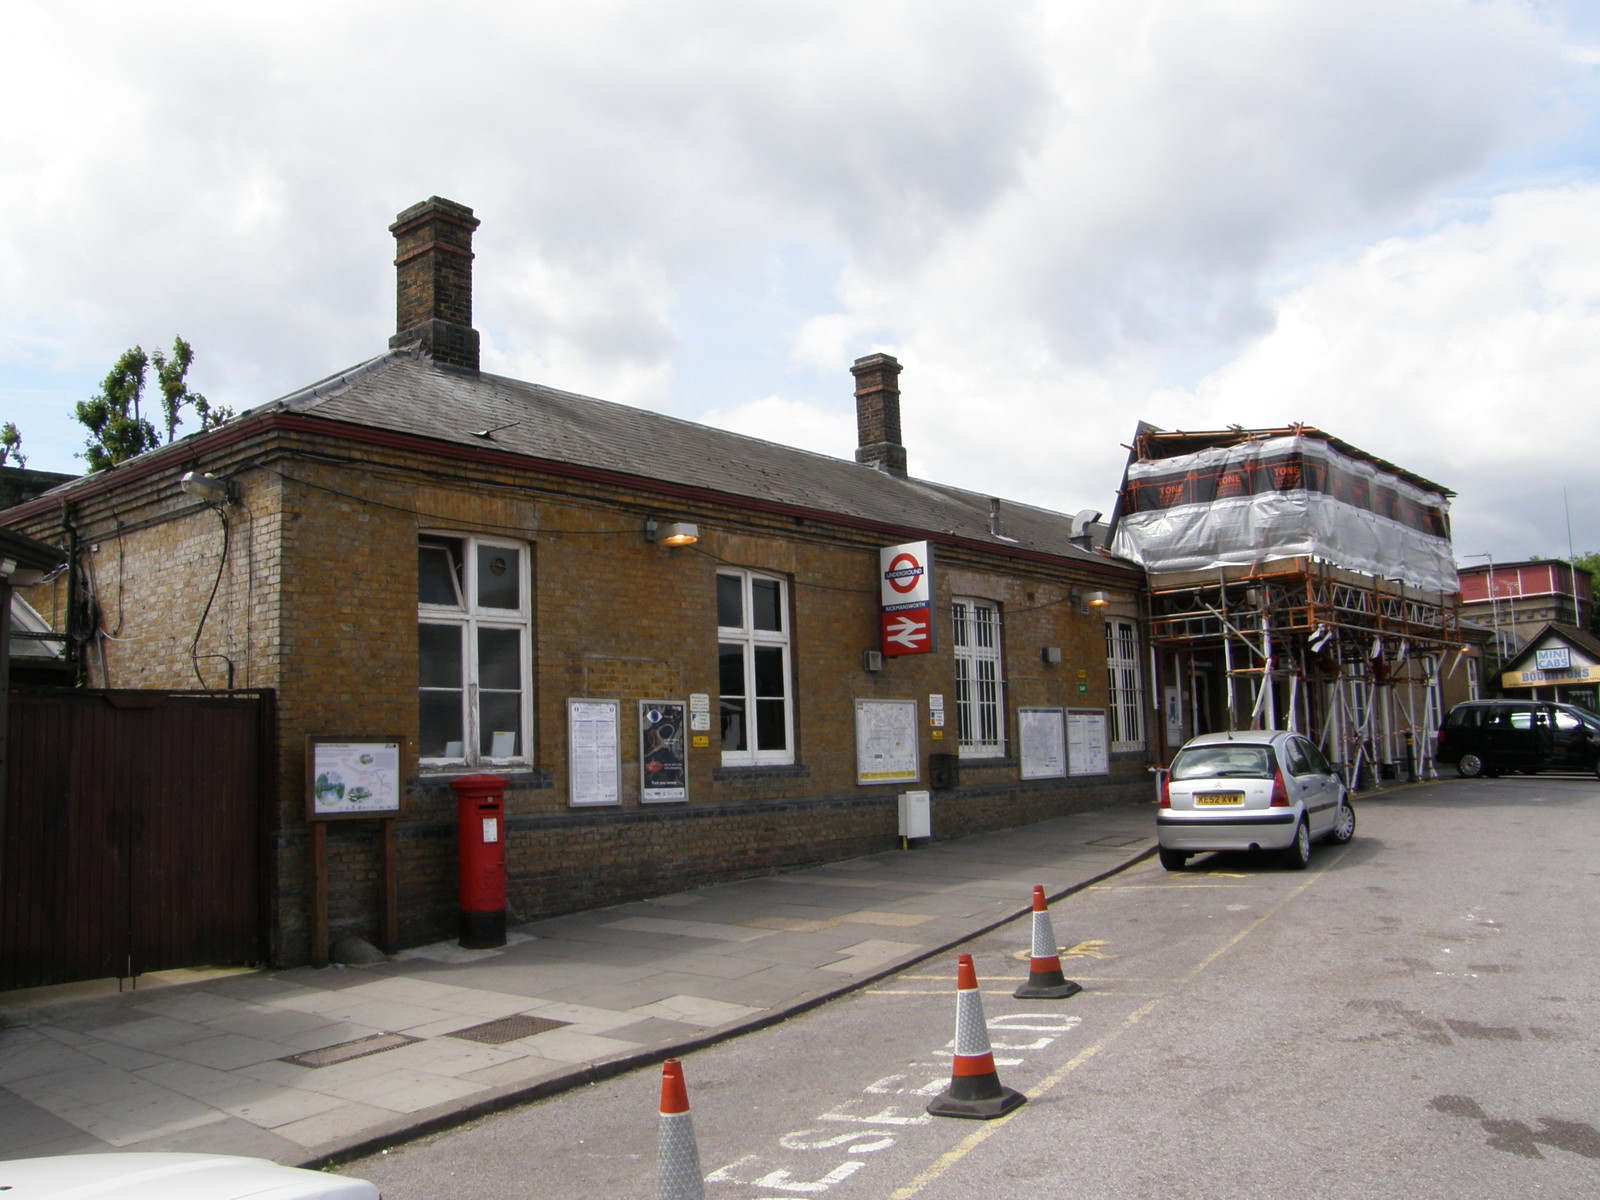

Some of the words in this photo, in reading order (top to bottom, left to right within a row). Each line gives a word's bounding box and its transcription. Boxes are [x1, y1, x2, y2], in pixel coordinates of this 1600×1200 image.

[1273, 466, 1299, 476] TONE
[1216, 475, 1241, 486] TONE
[1159, 485, 1183, 495] TONE
[886, 568, 922, 578] UNDERGROUND
[885, 602, 926, 611] RICKMANSWORTH
[1539, 650, 1566, 659] MINI
[1538, 659, 1569, 667] CABS
[1198, 795, 1219, 804] KE52
[704, 1013, 1082, 1200] ESERVED
